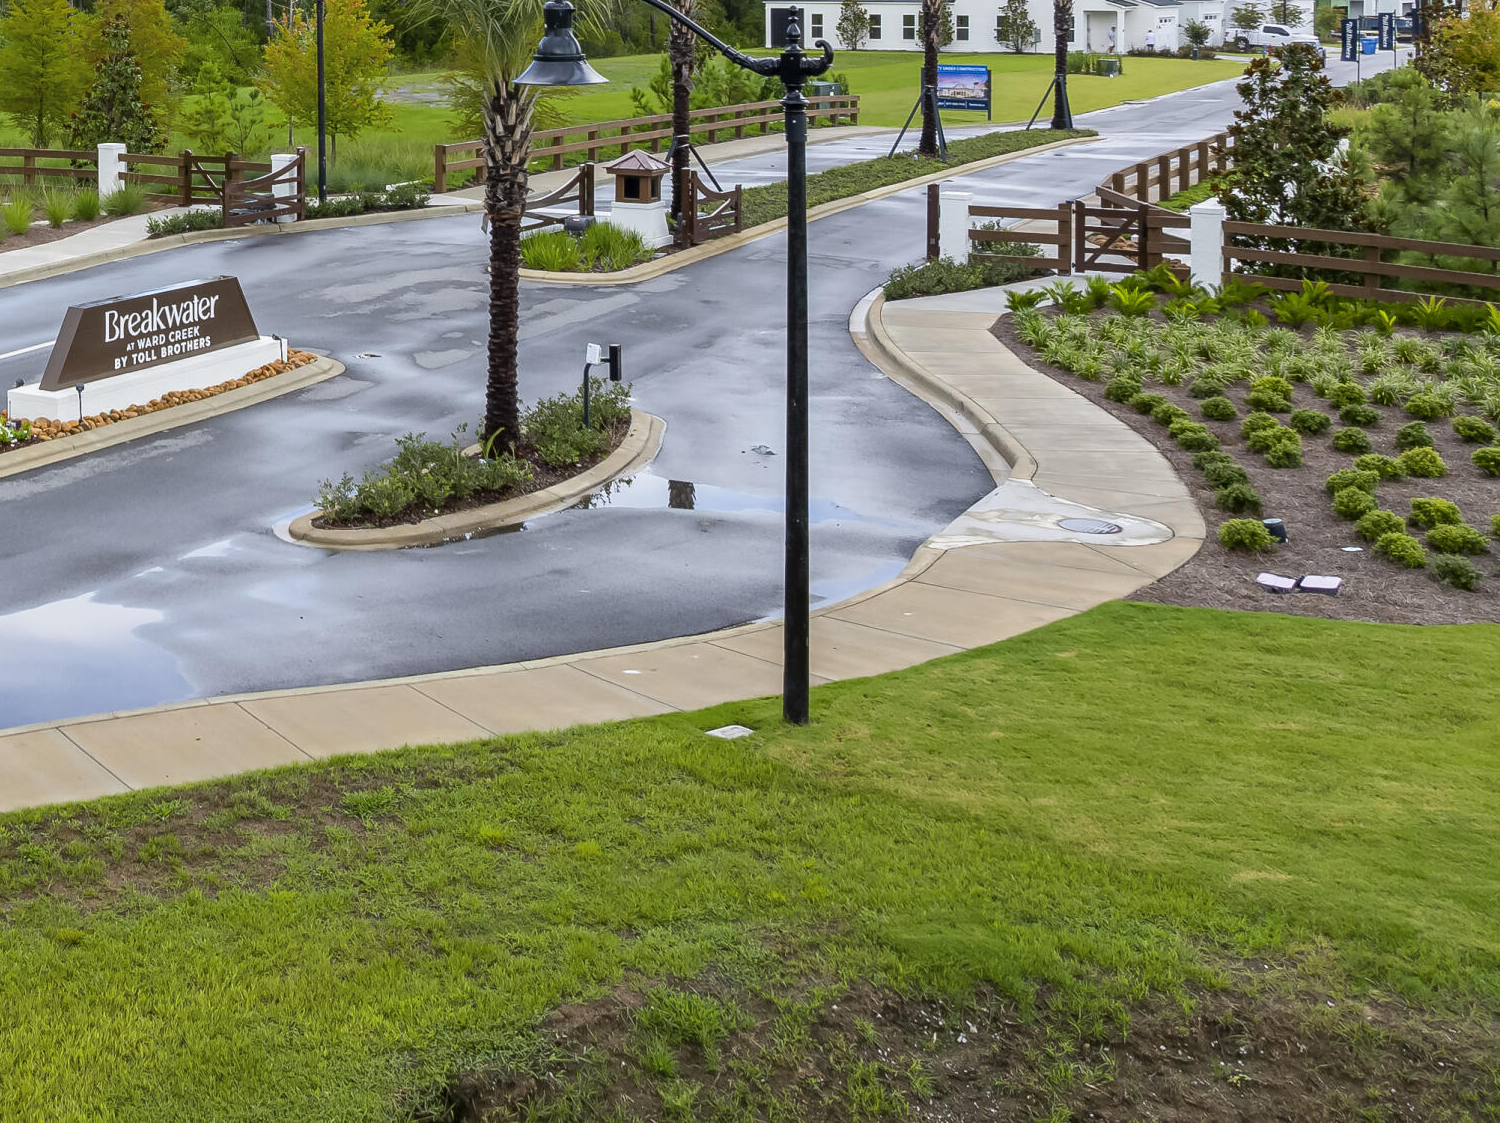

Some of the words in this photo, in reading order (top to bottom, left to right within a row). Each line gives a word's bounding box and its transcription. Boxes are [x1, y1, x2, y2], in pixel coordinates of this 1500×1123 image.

[104, 294, 219, 343] Breakwater
[114, 355, 128, 370] BY
[132, 349, 157, 365] TOLL
[161, 335, 211, 358] BROTHERS
[126, 342, 135, 352] AT
[136, 334, 166, 350] WARD
[168, 325, 200, 342] CREEK
